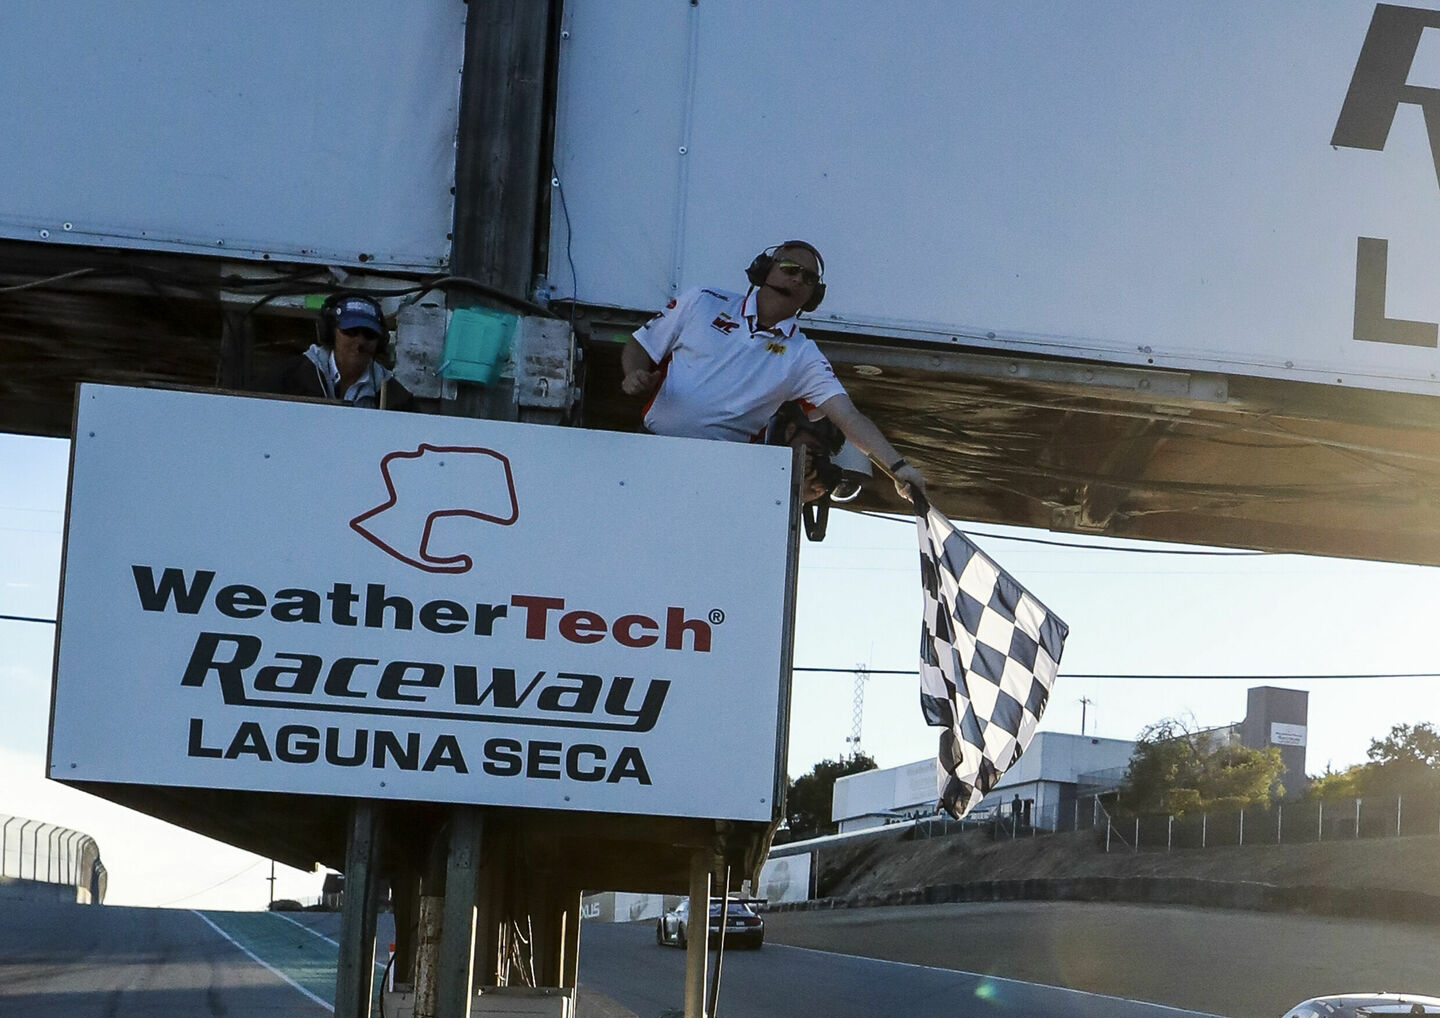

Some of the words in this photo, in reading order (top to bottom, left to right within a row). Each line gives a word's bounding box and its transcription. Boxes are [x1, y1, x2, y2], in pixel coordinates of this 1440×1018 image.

[181, 631, 670, 733] Raceway
[188, 718, 469, 774] LAGUNA
[483, 737, 652, 786] SECA
